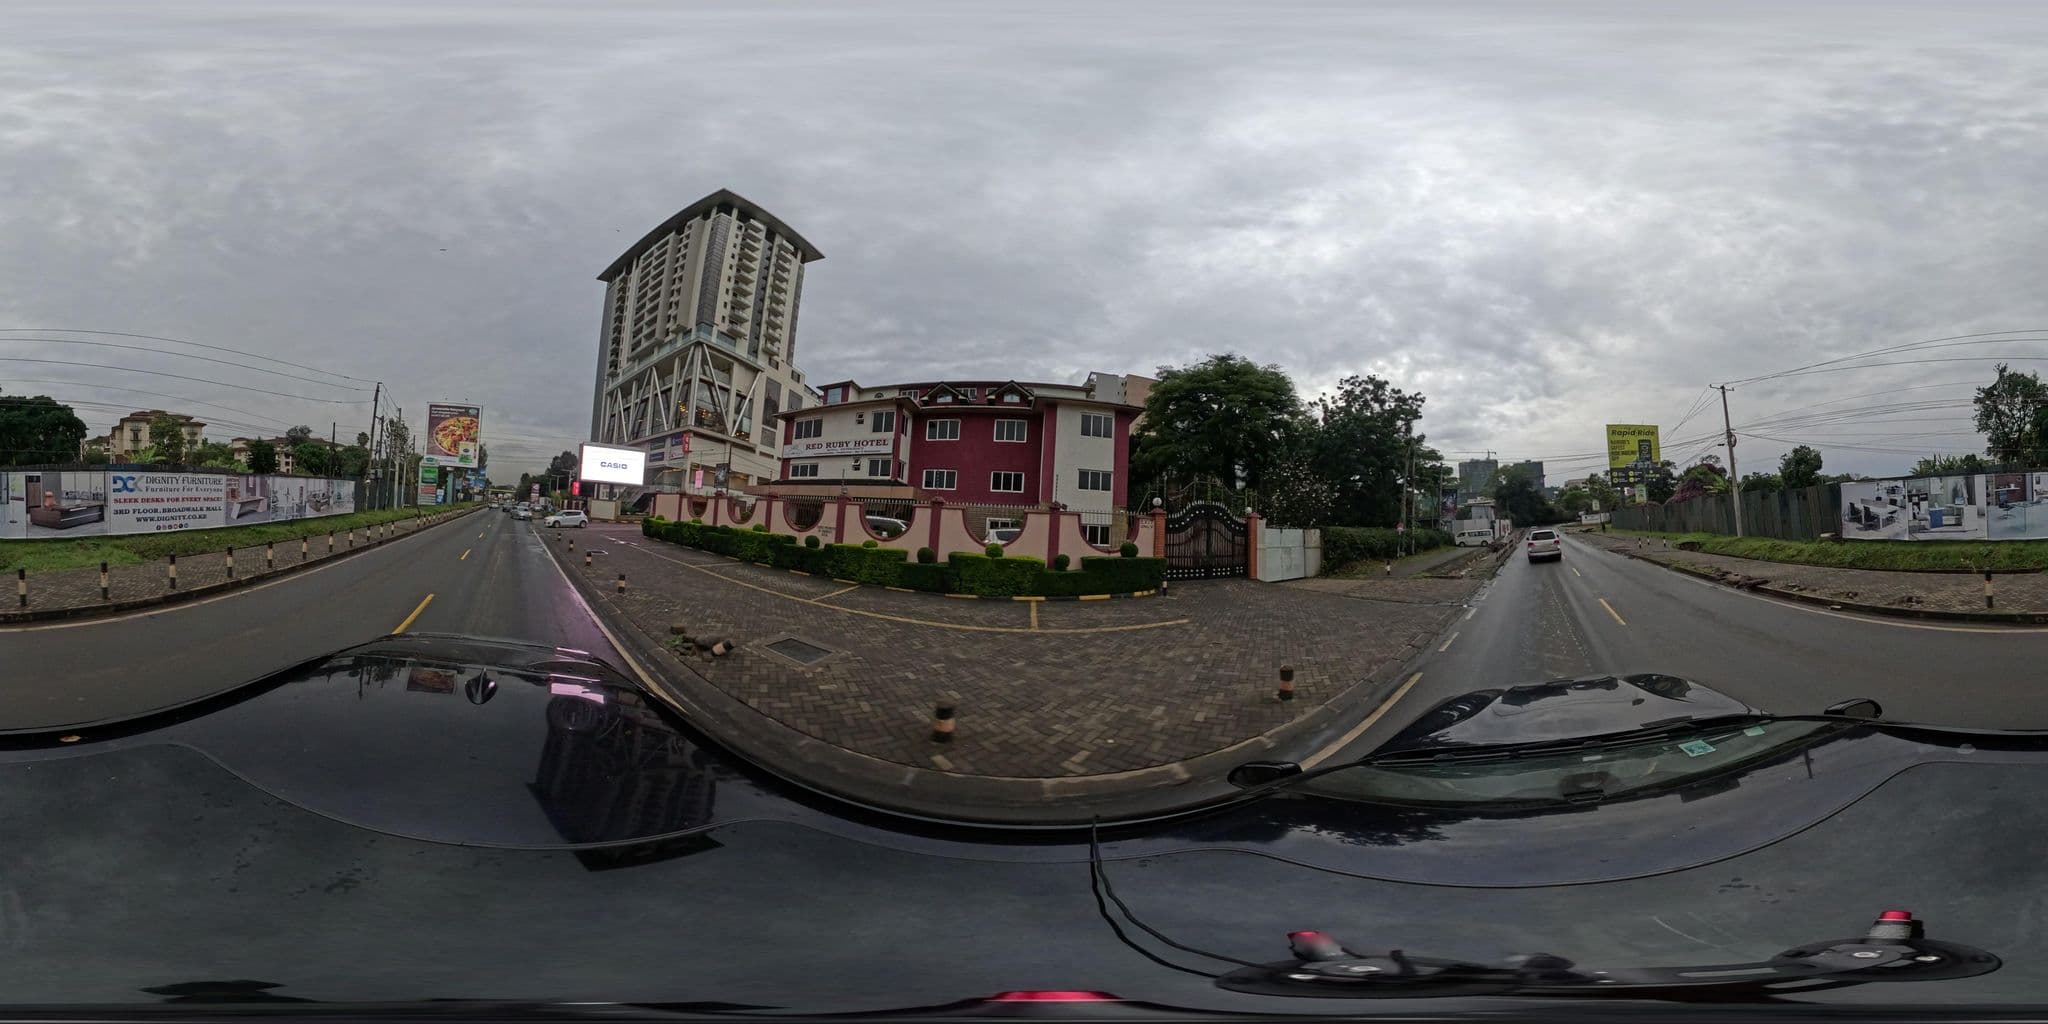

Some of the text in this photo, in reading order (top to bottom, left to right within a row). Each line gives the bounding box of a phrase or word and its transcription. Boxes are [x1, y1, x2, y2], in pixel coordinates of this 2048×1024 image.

[1611, 429, 1636, 437] Rapid
[854, 439, 889, 447] HOTEL
[600, 461, 627, 470] CASIO
[145, 476, 223, 485] DIGNITY FURNITURE
[136, 514, 207, 522] WWW.DIGNITY.CO.KE
